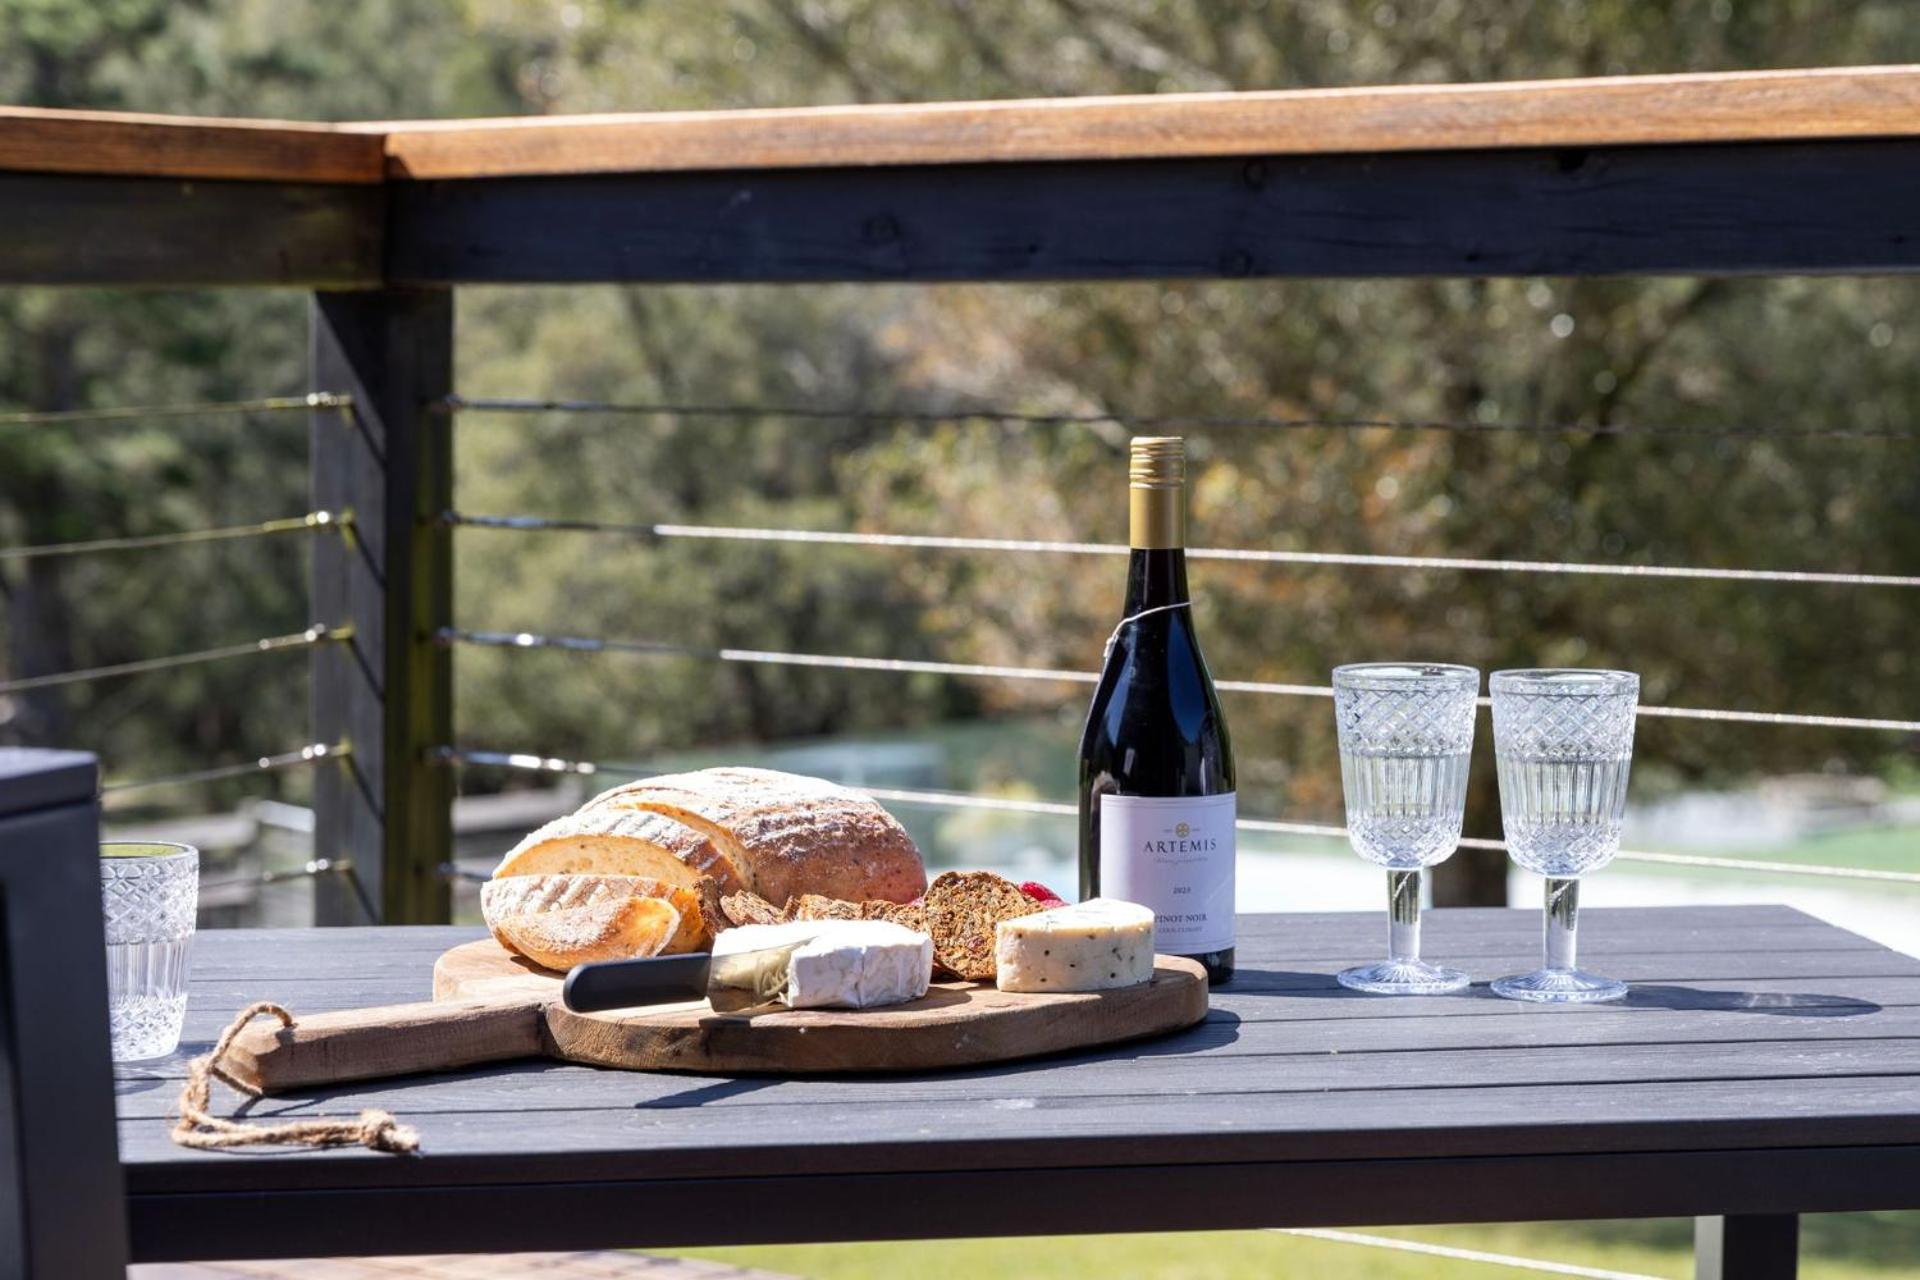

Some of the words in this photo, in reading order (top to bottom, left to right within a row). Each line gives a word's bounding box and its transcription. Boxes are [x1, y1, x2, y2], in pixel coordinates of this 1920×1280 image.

[1145, 838, 1217, 853] ARTEMIS
[1154, 914, 1183, 923] PINOT
[1185, 912, 1207, 922] NOIR
